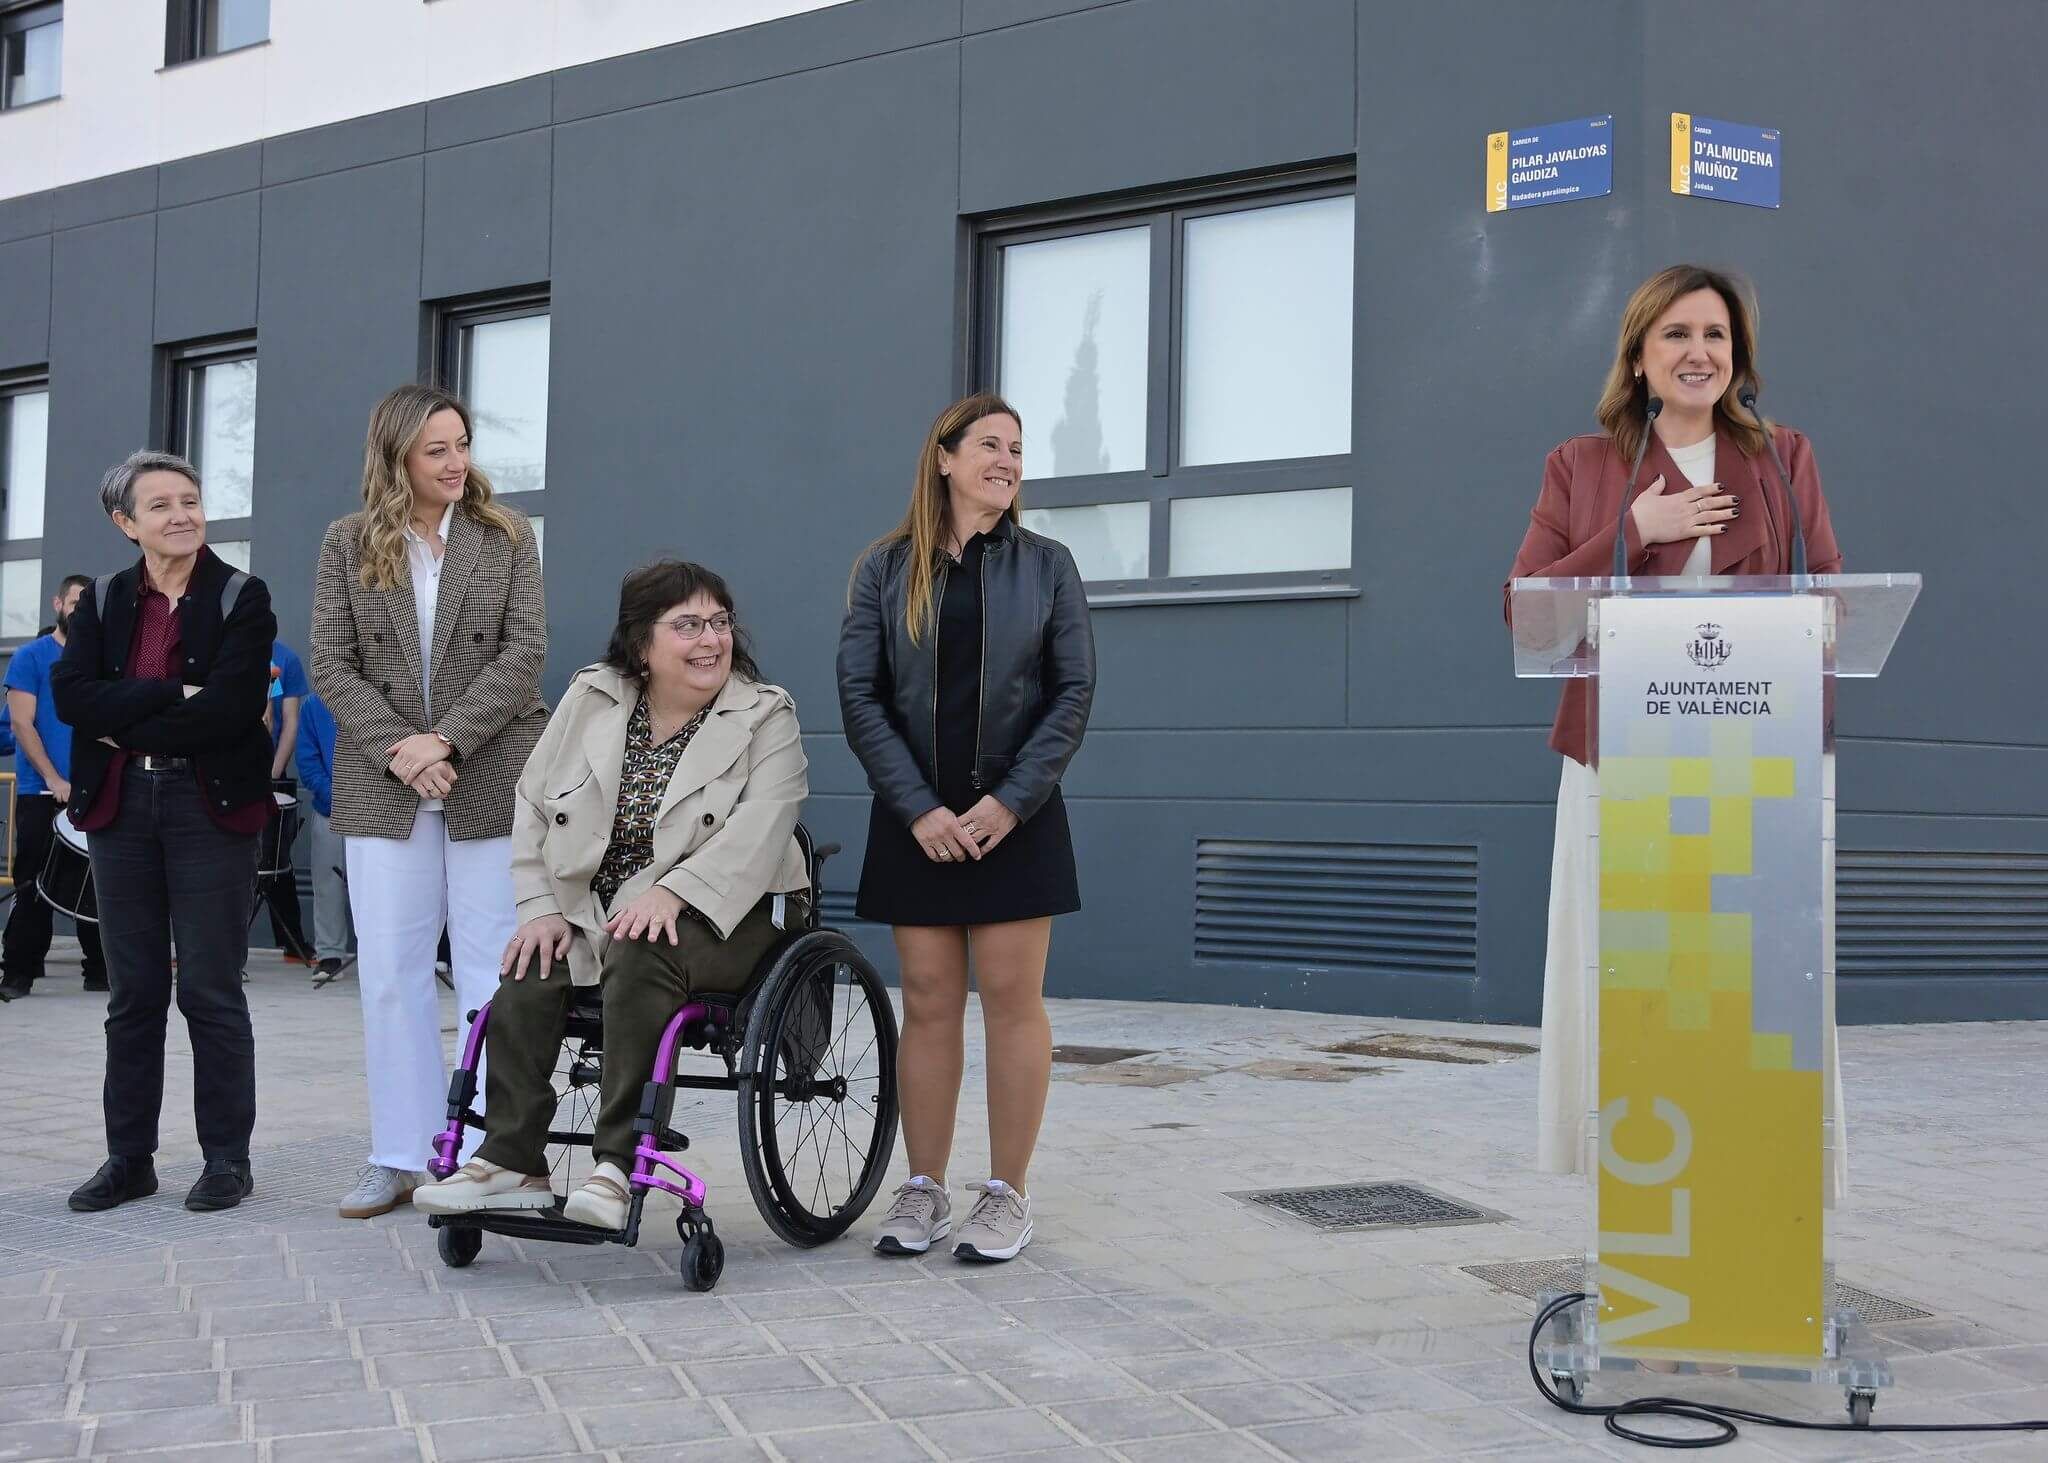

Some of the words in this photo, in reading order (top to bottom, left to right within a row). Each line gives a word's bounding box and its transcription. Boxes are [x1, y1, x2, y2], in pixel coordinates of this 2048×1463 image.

[1512, 138, 1531, 146] CARRER
[1512, 154, 1543, 169] PILAR
[1546, 144, 1607, 164] JAVALOYAS
[1694, 141, 1773, 167] D'ALMUDENA
[1512, 167, 1558, 184] GAUDIZA
[1680, 164, 1691, 195] VLC
[1694, 160, 1738, 181] MUÑOZ
[1496, 182, 1507, 211] VLC
[1511, 192, 1541, 202] Nadadora
[1646, 681, 1772, 696] AJUNTAMENT
[1646, 700, 1671, 715] DE
[1677, 697, 1772, 715] VALÈNCIA
[1597, 1095, 1693, 1345] VLC
